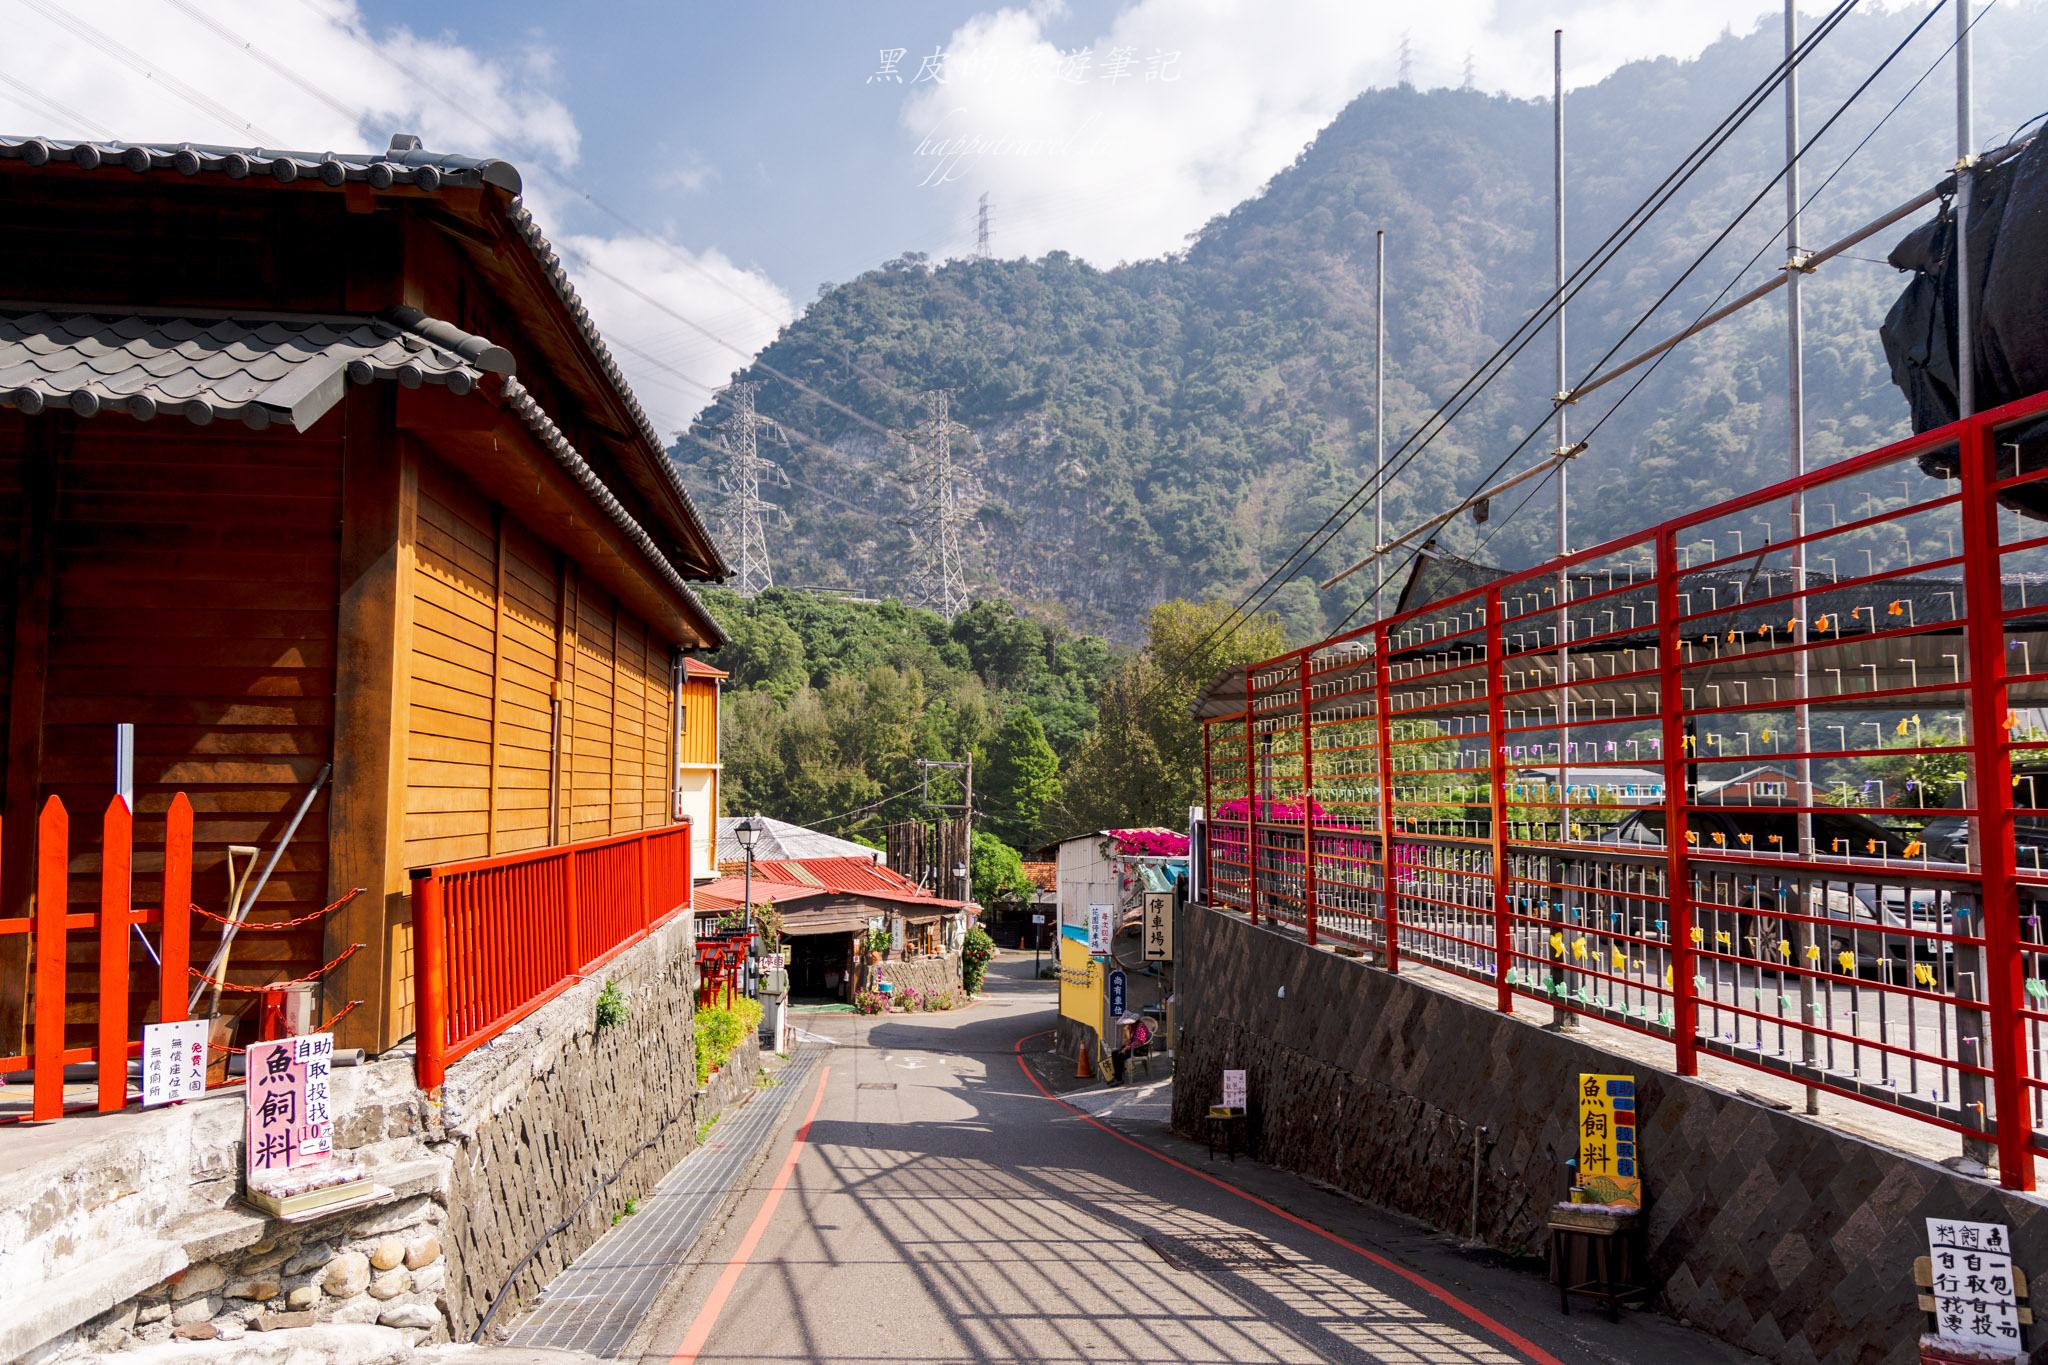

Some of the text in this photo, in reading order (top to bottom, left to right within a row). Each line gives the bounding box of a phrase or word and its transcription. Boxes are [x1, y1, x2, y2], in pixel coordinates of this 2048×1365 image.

[1149, 898, 1165, 947] 停車場
[189, 1042, 203, 1091] 免費入園
[299, 1038, 331, 1059] 自助
[256, 1045, 297, 1169] 魚飼料
[1581, 1076, 1611, 1173] 魚飼料
[302, 1124, 333, 1141] 10元
